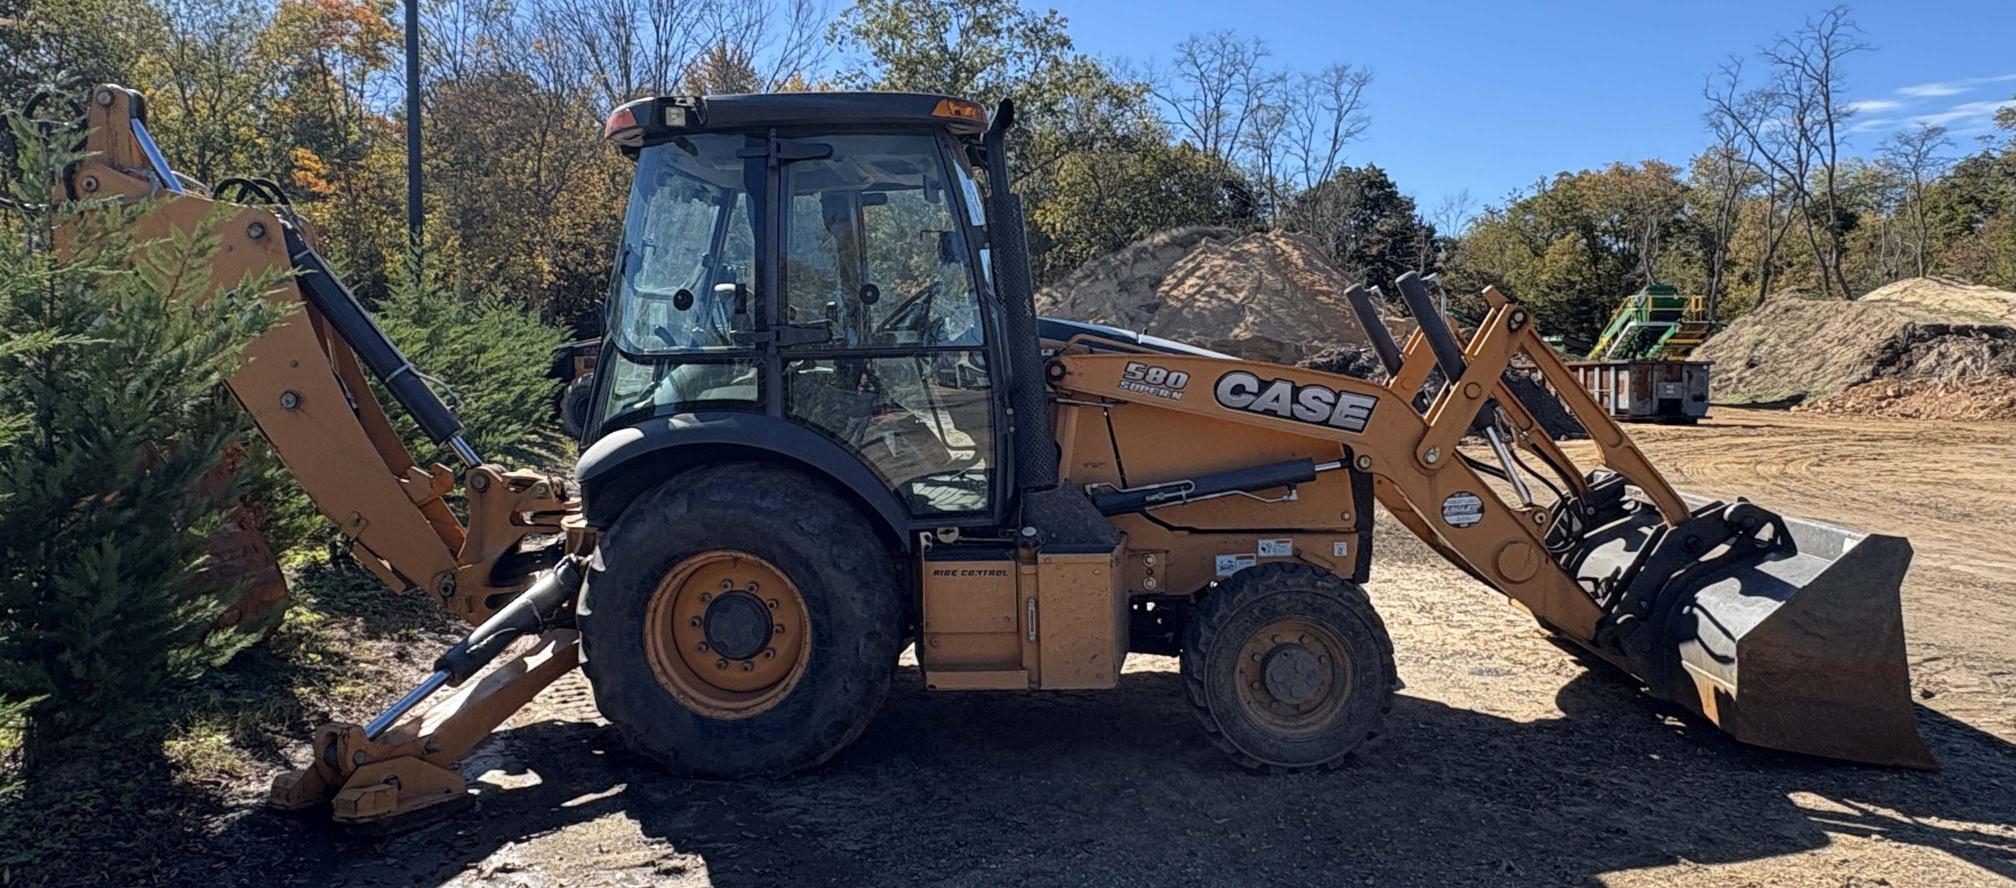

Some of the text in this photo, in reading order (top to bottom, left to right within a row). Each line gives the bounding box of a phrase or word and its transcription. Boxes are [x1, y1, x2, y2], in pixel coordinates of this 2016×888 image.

[1123, 361, 1190, 390] 580
[1118, 380, 1183, 400] SUPER N
[1215, 370, 1379, 432] CASE
[933, 569, 1008, 577] RIDE CONTROL
